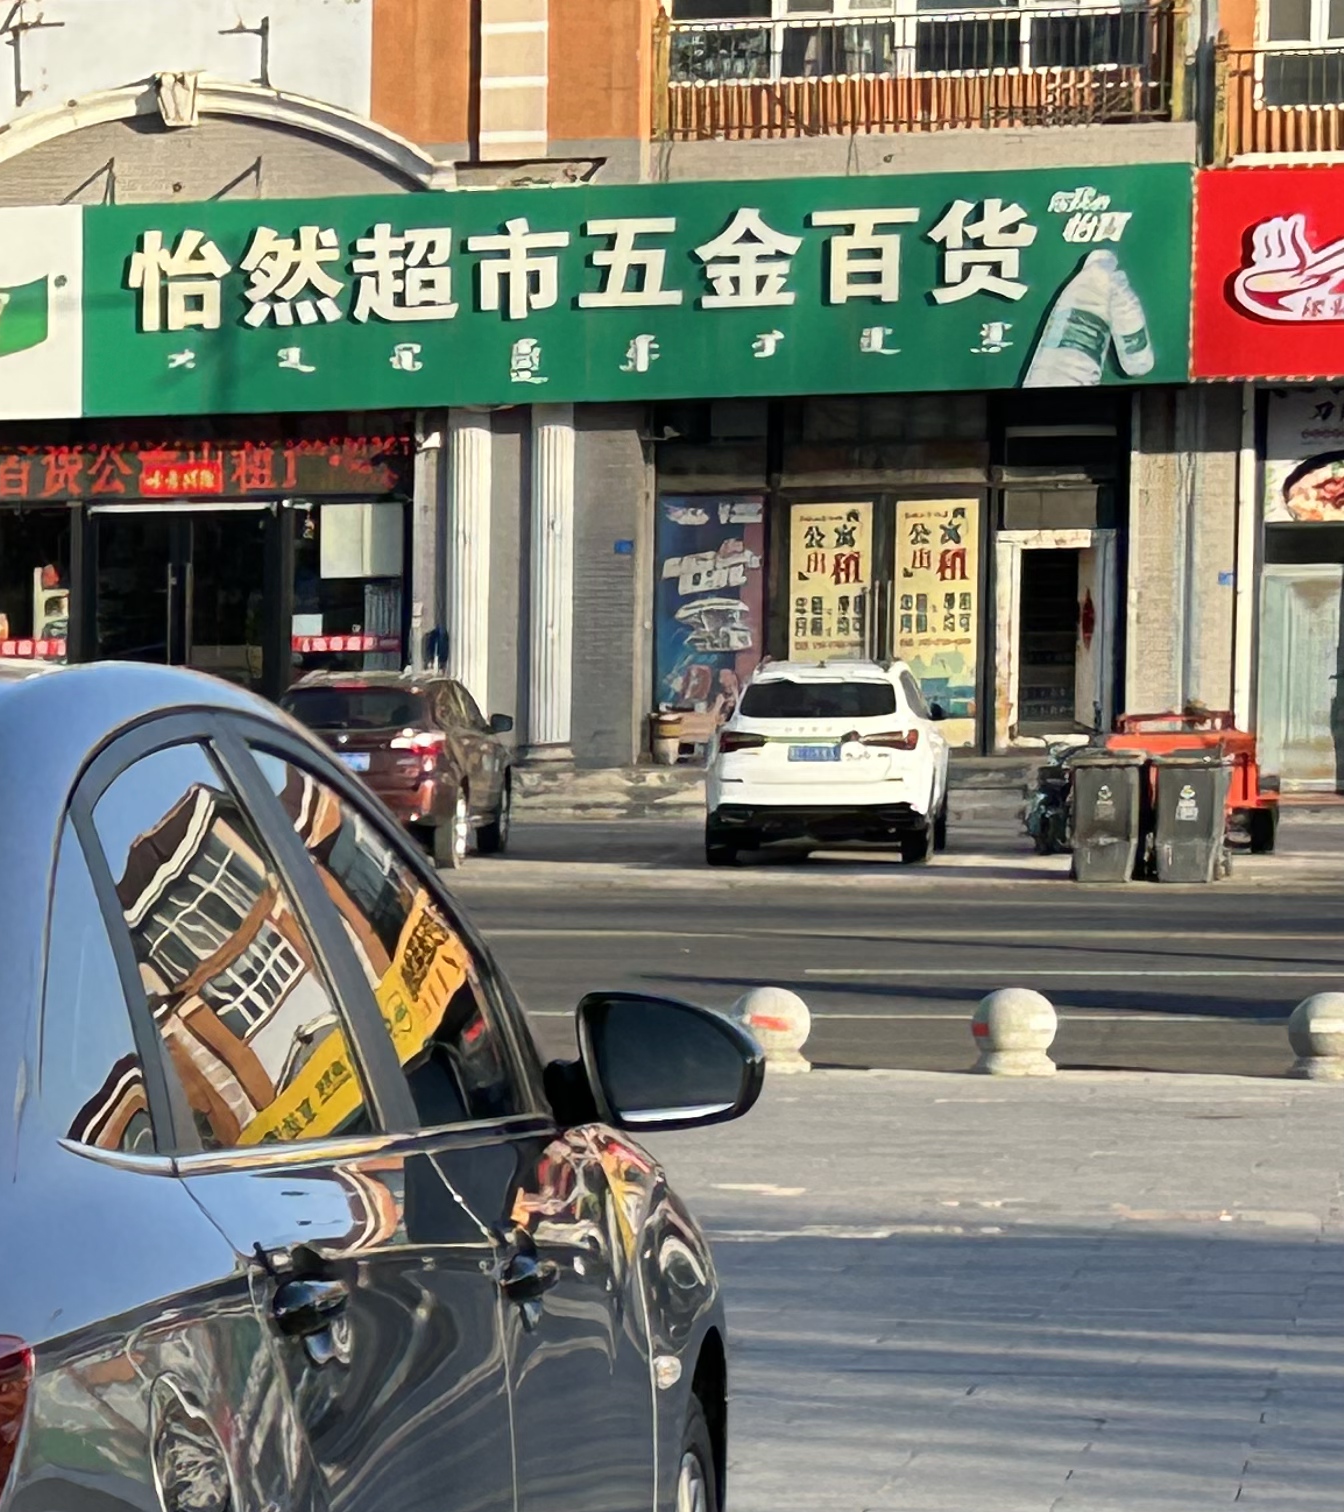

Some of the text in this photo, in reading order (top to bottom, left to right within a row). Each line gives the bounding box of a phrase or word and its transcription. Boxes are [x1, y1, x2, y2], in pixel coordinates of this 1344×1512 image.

[128, 198, 1038, 333] 怡然超市五金百货
